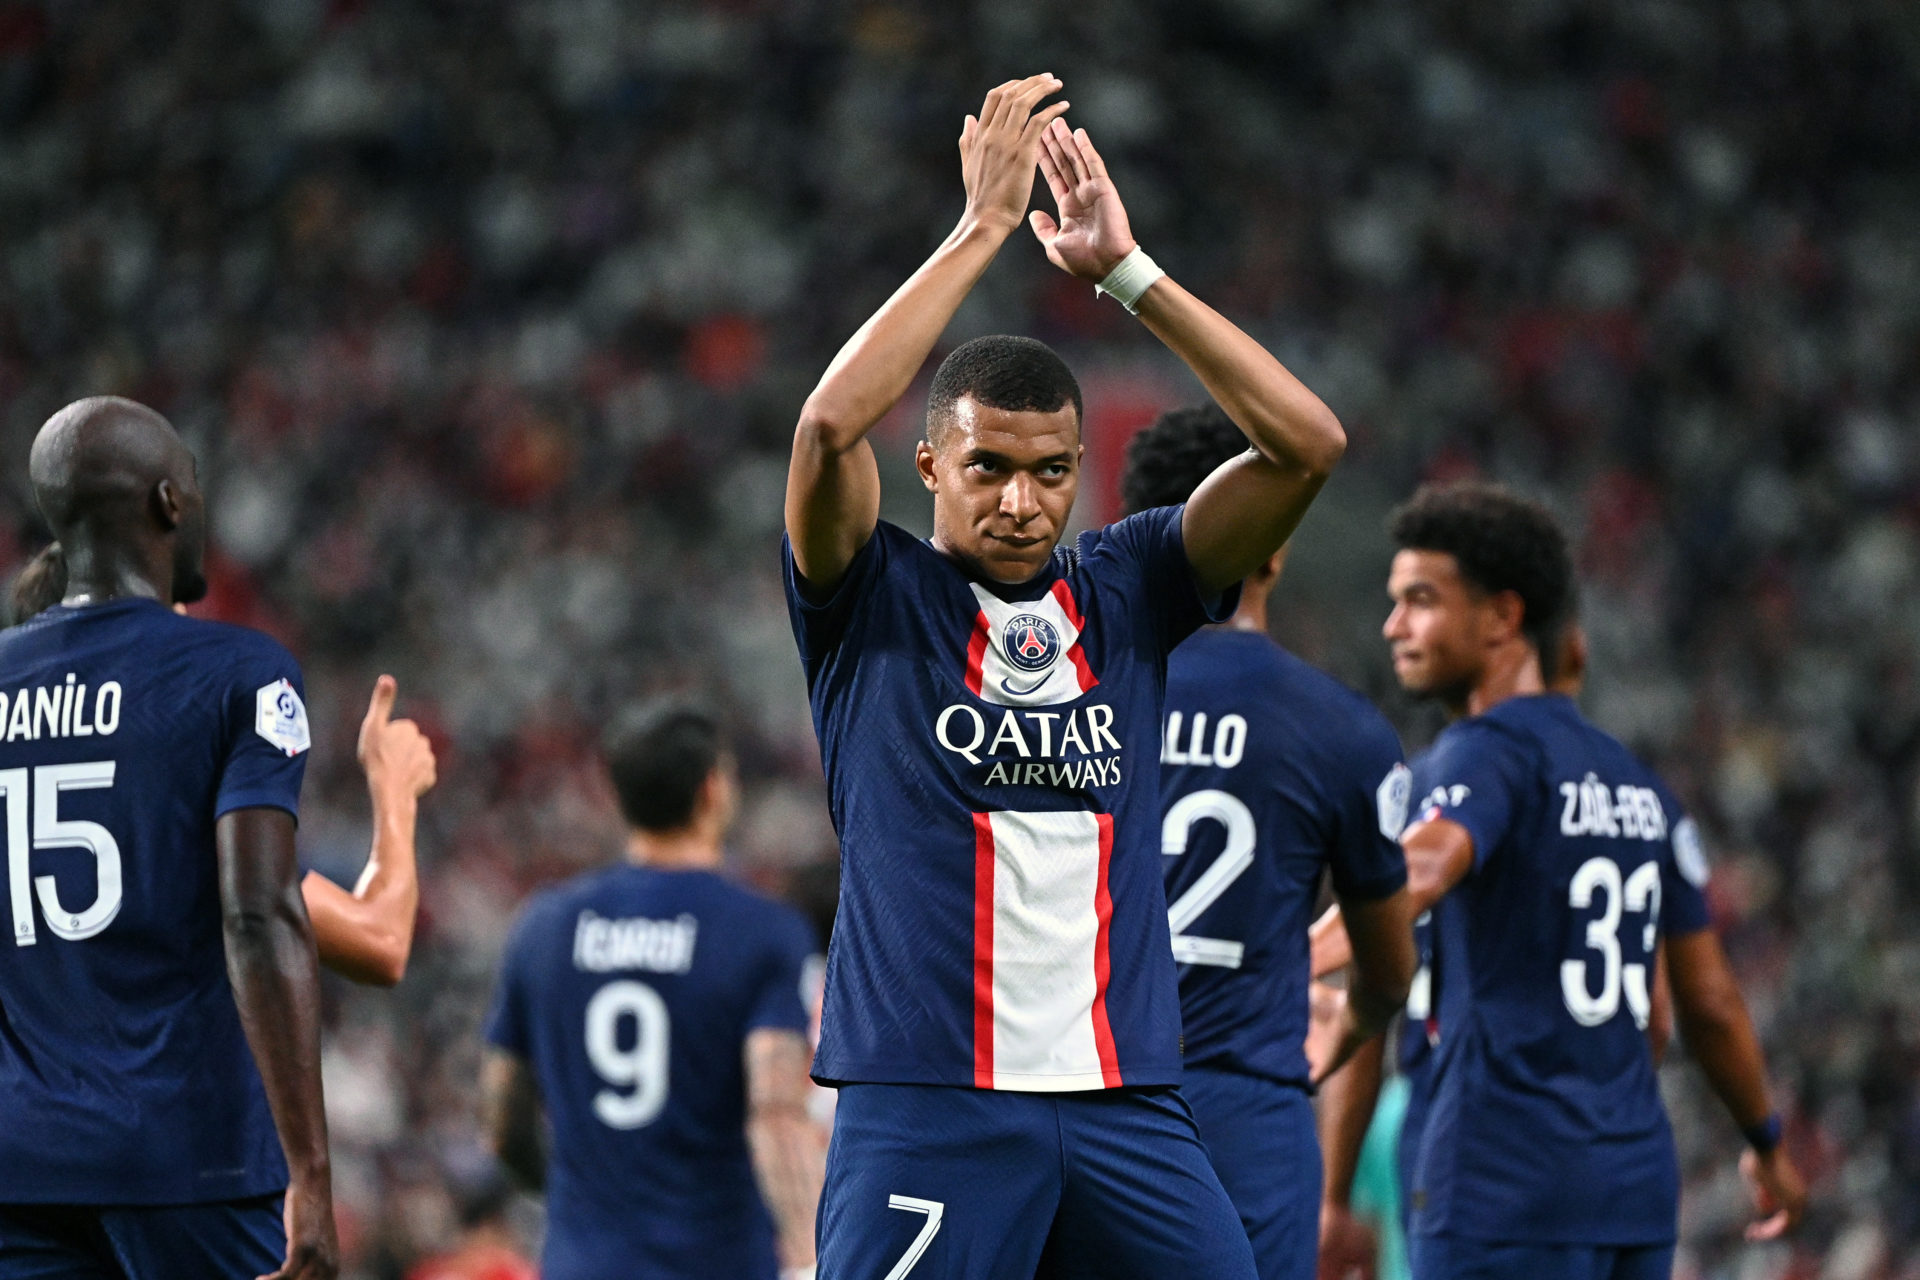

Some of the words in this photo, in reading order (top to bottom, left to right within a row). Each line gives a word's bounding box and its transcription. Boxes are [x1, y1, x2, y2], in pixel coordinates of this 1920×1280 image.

[1011, 617, 1047, 631] PARIS
[935, 704, 1122, 765] QATAR
[1160, 710, 1248, 769] LLO
[984, 756, 1121, 789] AIRWAYS
[0, 760, 122, 947] 15
[1161, 789, 1257, 969] 2
[584, 978, 671, 1131] 9
[888, 1194, 945, 1280] 7
